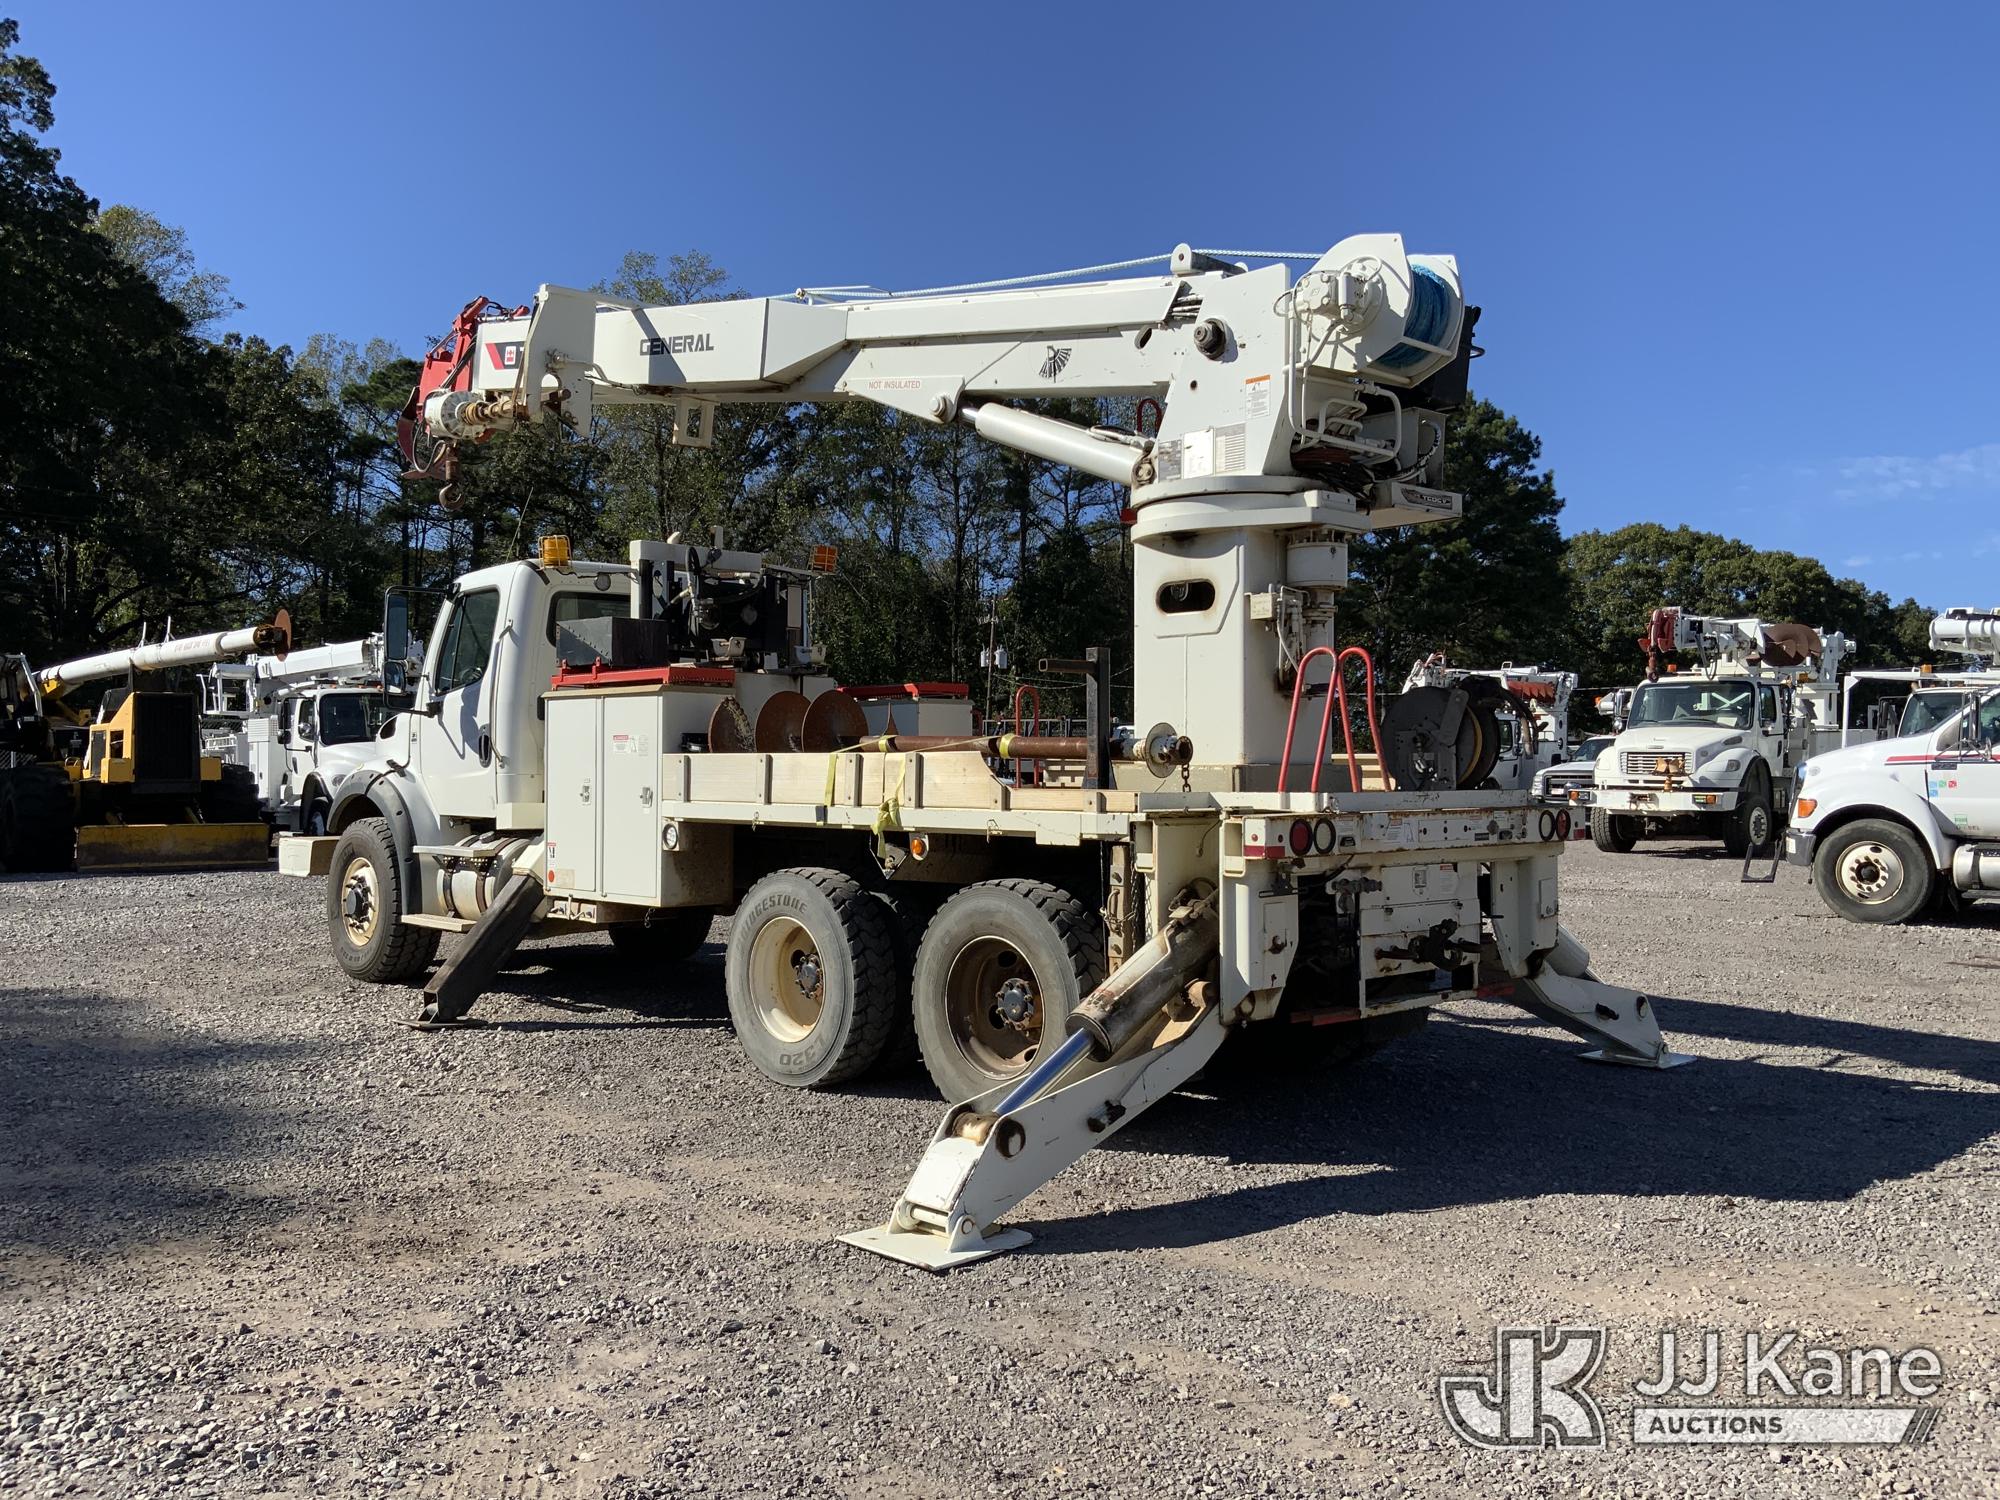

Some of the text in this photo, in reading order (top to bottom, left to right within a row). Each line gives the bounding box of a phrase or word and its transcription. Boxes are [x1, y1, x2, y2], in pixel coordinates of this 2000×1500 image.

[640, 333, 714, 356] GENERAL
[868, 380, 921, 390] NOT INSULATED
